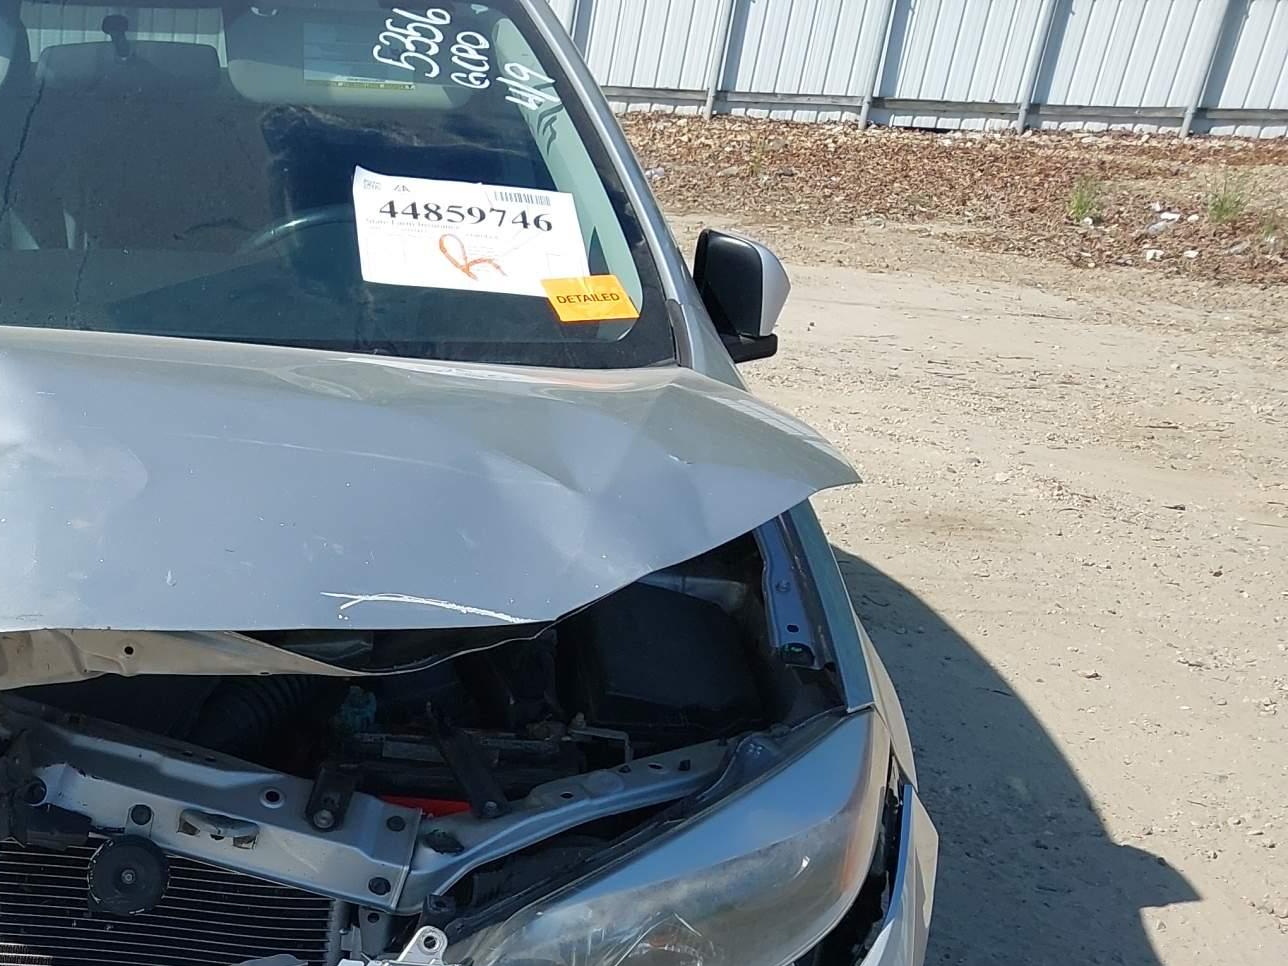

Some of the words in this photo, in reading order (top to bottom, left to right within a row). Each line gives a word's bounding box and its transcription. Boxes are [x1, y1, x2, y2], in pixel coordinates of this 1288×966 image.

[373, 8, 451, 78] 5356
[379, 199, 553, 232] 44859746
[557, 292, 620, 305] DETAILED
